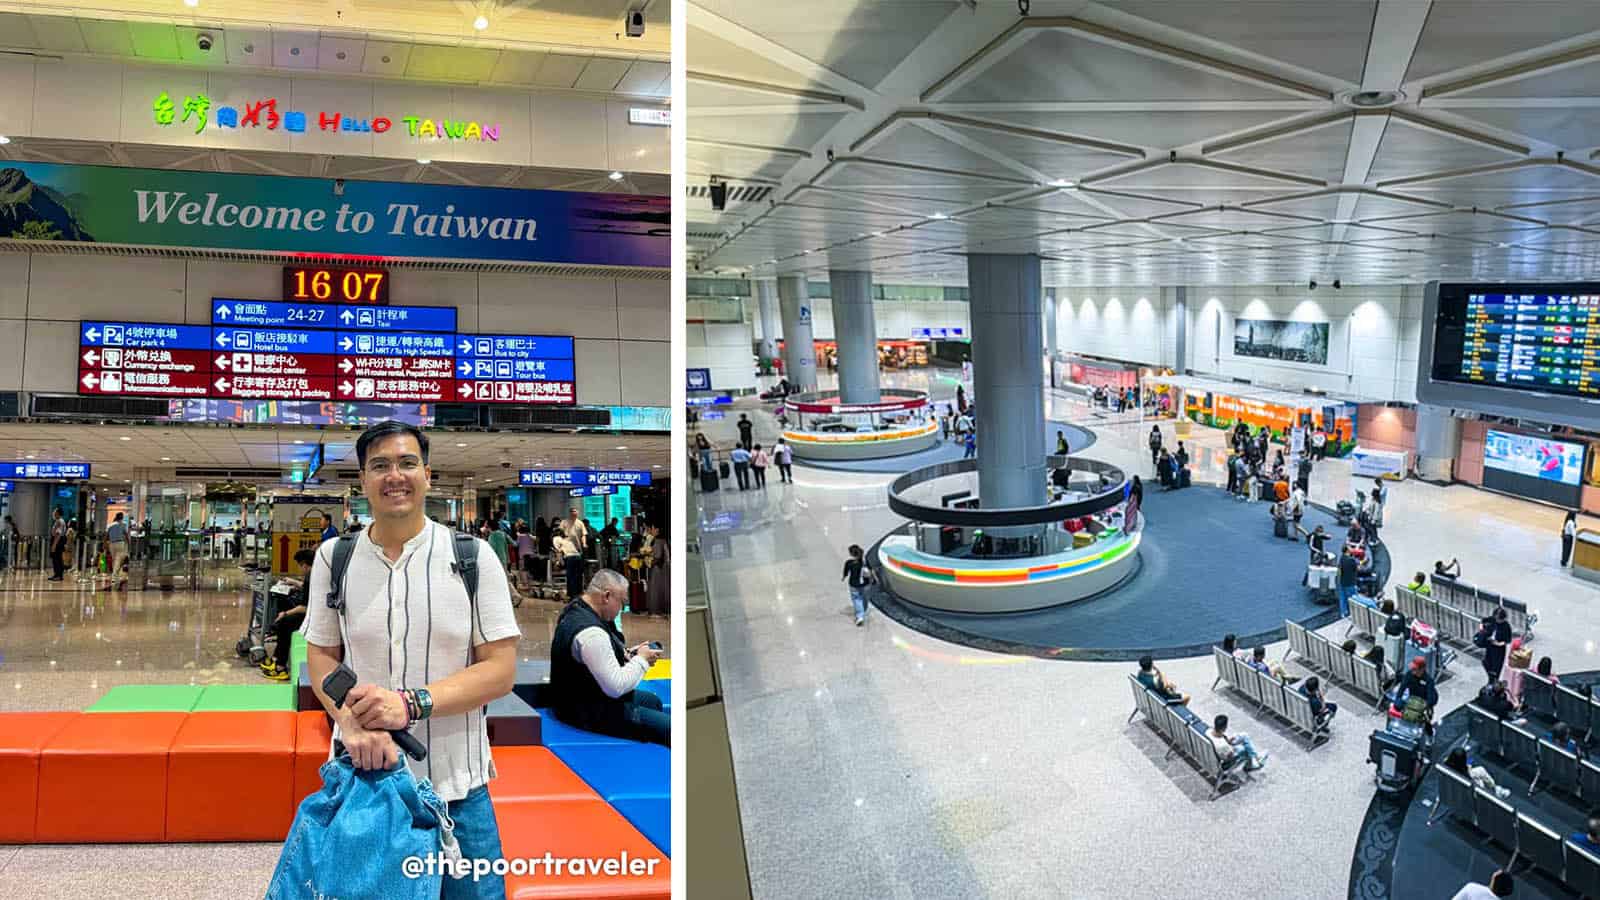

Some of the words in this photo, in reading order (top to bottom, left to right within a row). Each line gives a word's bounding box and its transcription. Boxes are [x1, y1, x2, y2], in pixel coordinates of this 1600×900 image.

[133, 189, 326, 234] Welcome
[336, 202, 375, 234] to
[387, 203, 539, 242] Taiwan
[291, 270, 332, 300] 16
[342, 271, 384, 302] 07
[234, 303, 267, 315] 會面點
[377, 309, 408, 320] 計程車
[234, 314, 264, 325] Meeting
[287, 308, 325, 322] 24-27
[126, 338, 141, 347] Car
[141, 339, 158, 348] park
[253, 343, 274, 352] Hotel
[275, 344, 289, 352] bus
[375, 347, 390, 355] MRT
